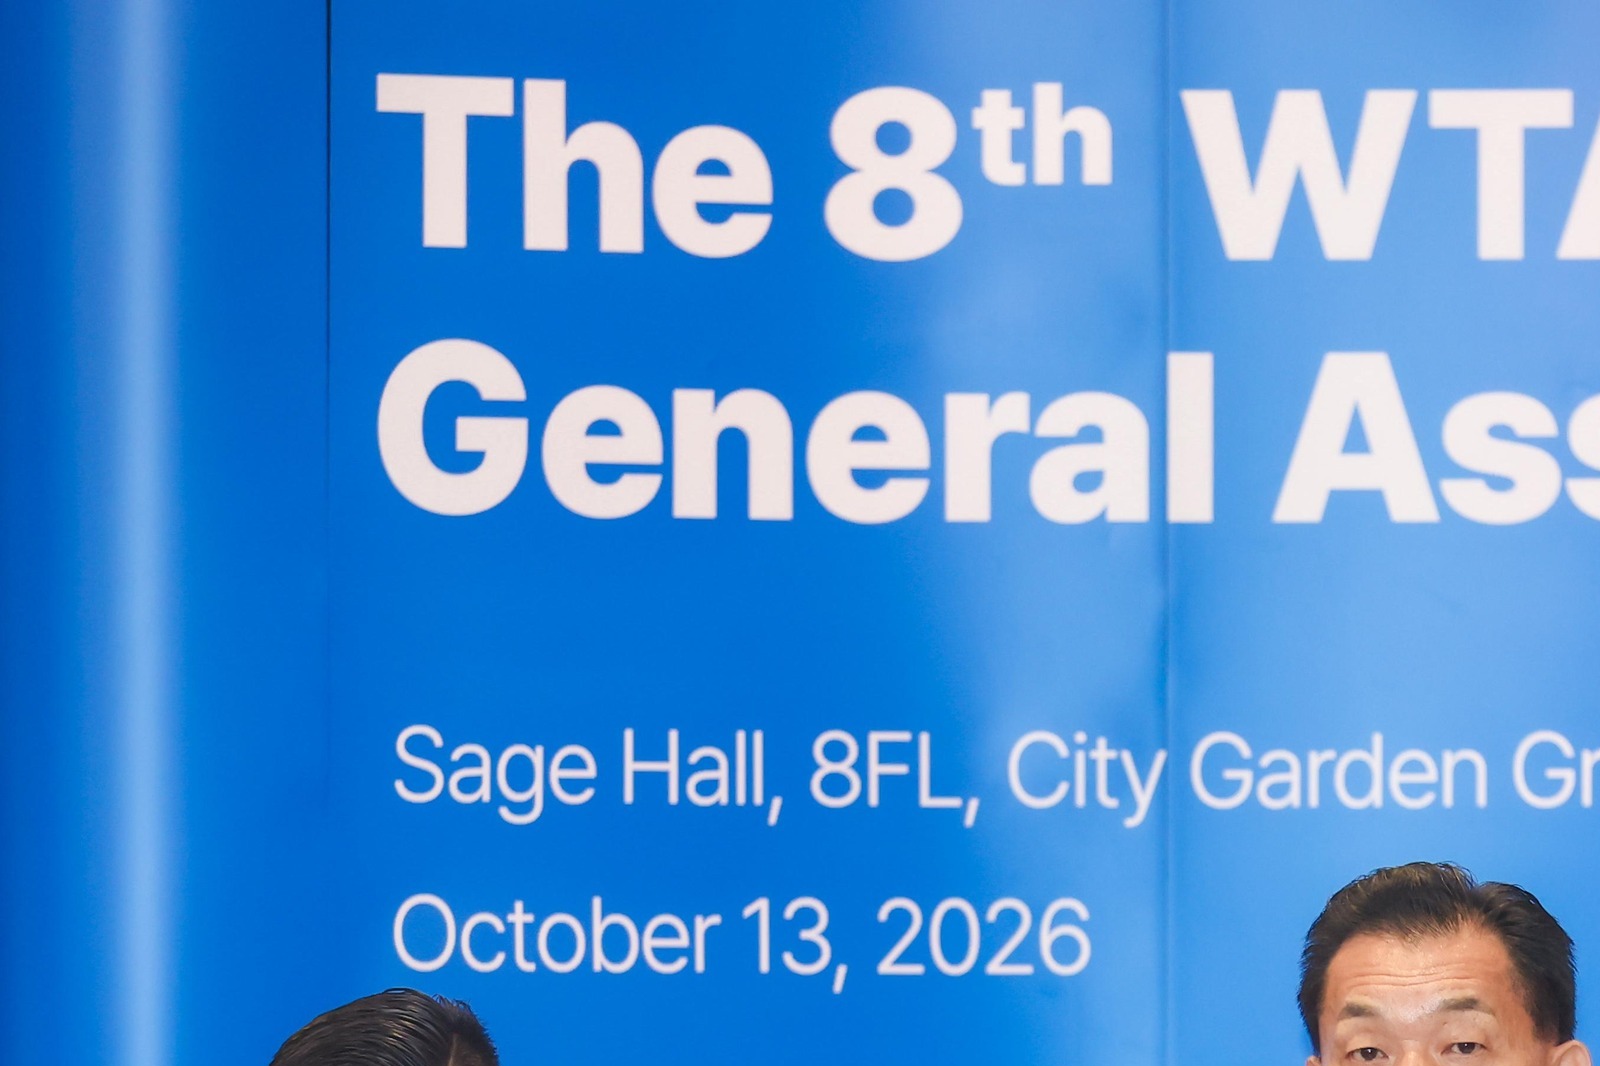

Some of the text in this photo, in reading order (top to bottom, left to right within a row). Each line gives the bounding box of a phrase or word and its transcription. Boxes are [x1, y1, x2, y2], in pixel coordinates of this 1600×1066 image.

[378, 75, 773, 258] The
[826, 83, 1113, 262] 8th
[378, 339, 1214, 525] General
[392, 725, 597, 824] Sage
[622, 728, 783, 826] Hall,
[810, 730, 980, 828] 8FL,
[1006, 729, 1168, 829] City
[1189, 731, 1489, 810] Garden
[392, 893, 1093, 993] October 13, 2026
